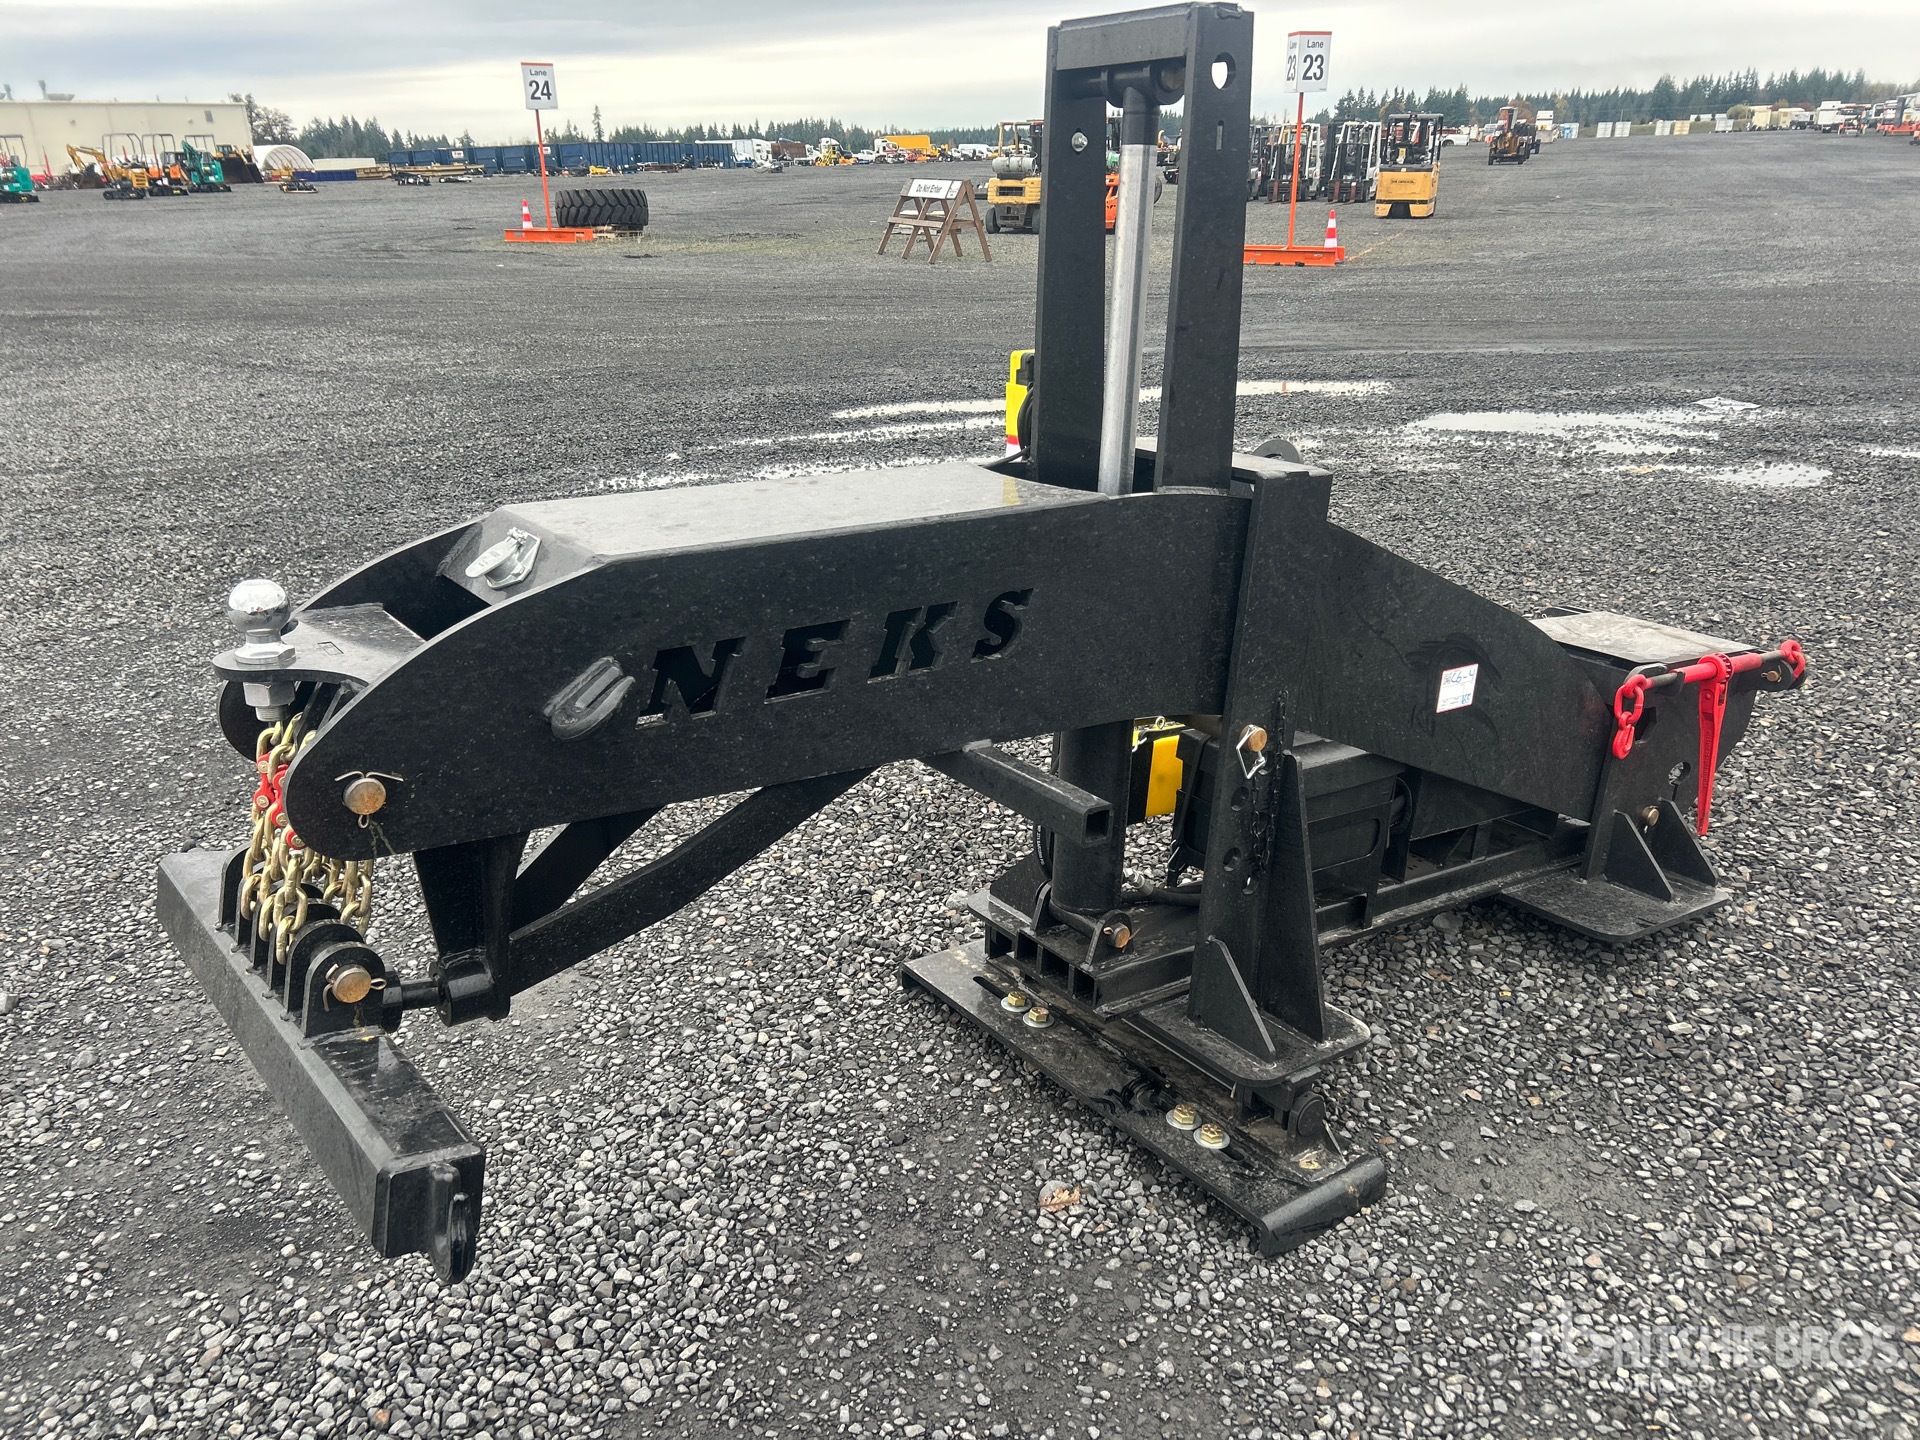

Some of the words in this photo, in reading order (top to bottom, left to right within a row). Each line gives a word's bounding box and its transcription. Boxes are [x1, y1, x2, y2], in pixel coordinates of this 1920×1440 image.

[1307, 39, 1324, 49] Lane
[1287, 54, 1297, 82] 23
[1302, 54, 1324, 81] 23
[529, 80, 552, 100] 24
[915, 184, 923, 193] Do
[923, 184, 931, 193] Not
[930, 184, 942, 194] Enter
